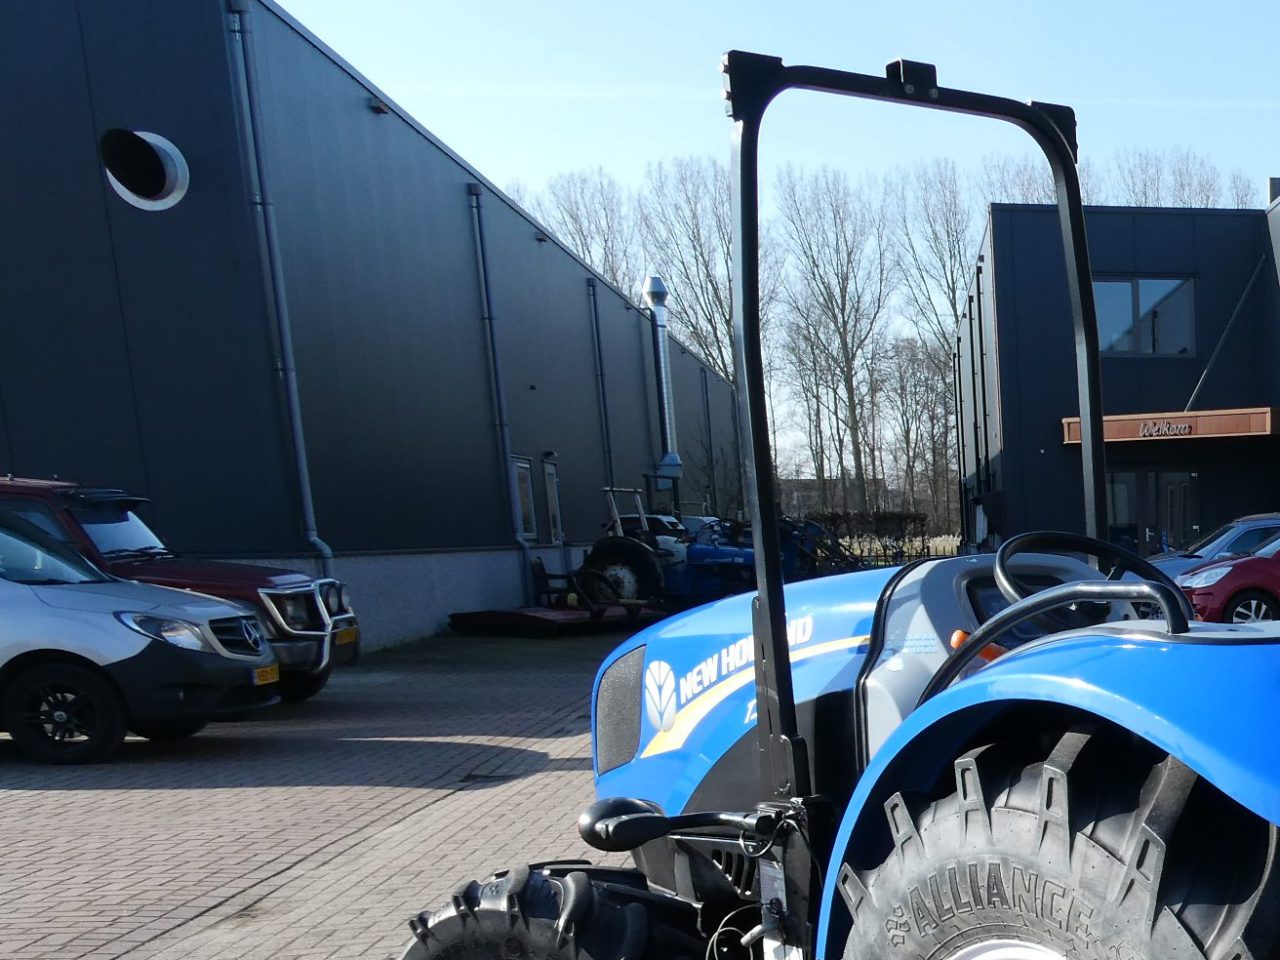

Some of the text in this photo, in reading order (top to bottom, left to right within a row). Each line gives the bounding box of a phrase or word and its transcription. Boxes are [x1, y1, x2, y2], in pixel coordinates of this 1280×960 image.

[1139, 421, 1192, 438] Welkom
[680, 653, 719, 705] NEW
[908, 861, 1097, 947] ALLIANCE
